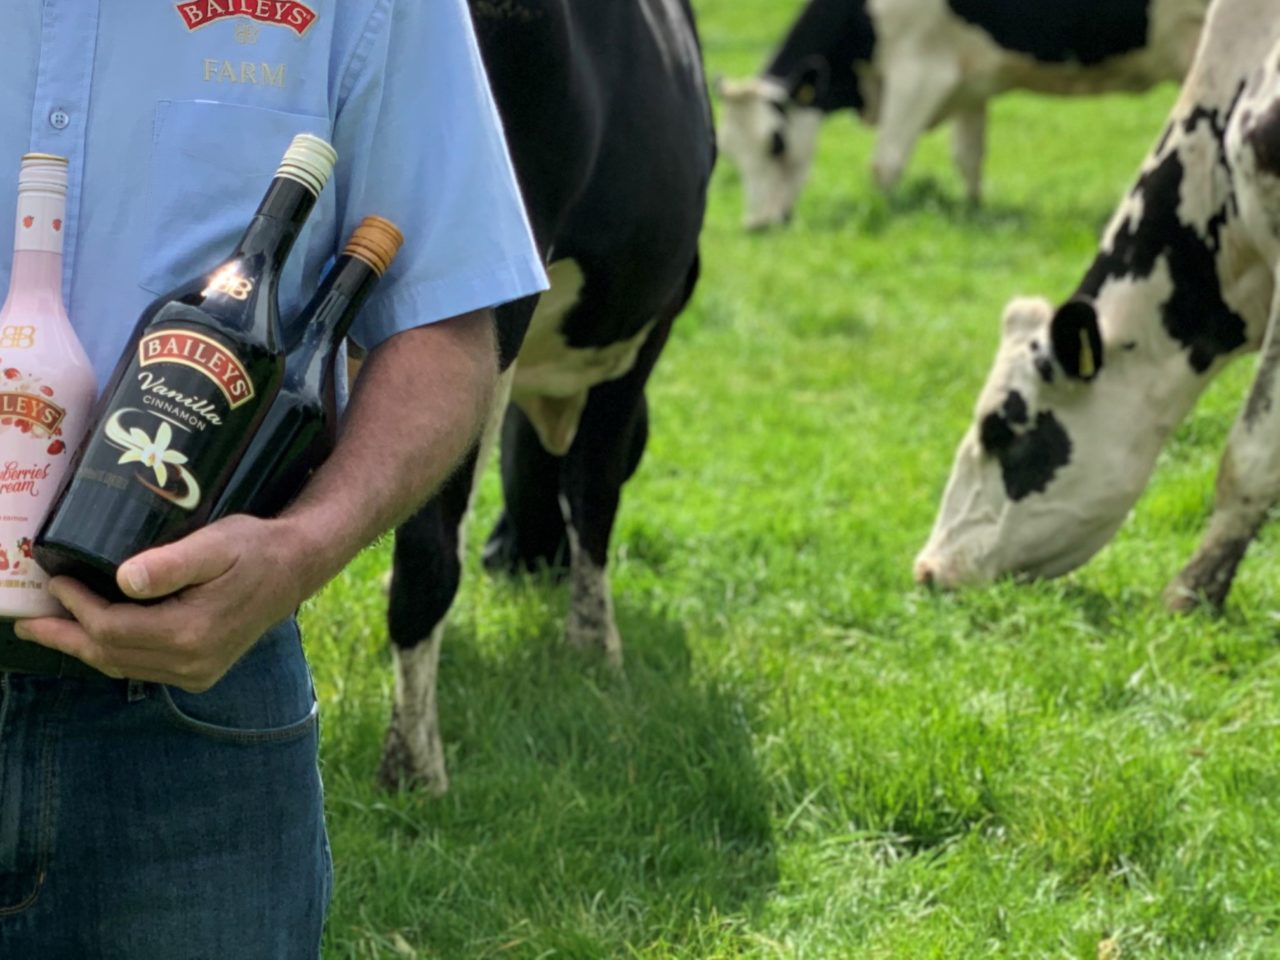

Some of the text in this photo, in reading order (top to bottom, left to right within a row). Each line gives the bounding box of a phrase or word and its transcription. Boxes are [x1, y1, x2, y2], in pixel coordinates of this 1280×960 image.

[202, 58, 286, 88] FARM
[148, 335, 248, 396] BAILEYS
[138, 371, 223, 425] Vanilla
[143, 394, 207, 431] CINNAMON
